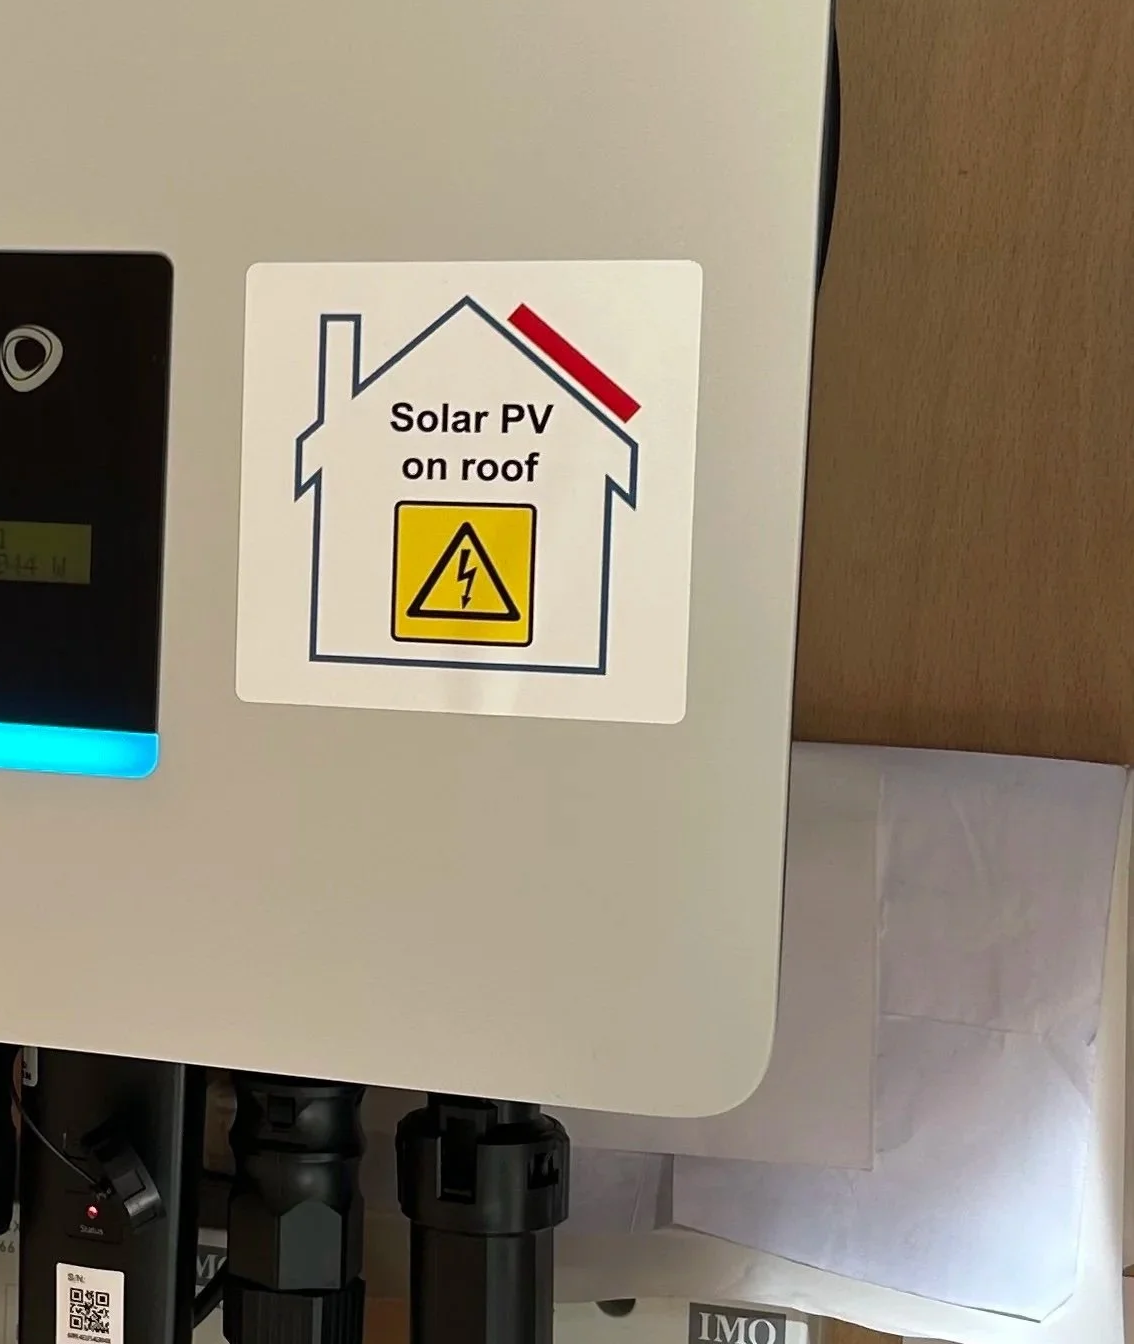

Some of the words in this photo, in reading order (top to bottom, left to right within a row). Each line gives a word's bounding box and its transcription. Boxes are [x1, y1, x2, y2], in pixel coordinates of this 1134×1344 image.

[390, 402, 489, 433] Solar
[501, 403, 554, 434] PV
[402, 457, 447, 480] on
[461, 451, 540, 482] roof
